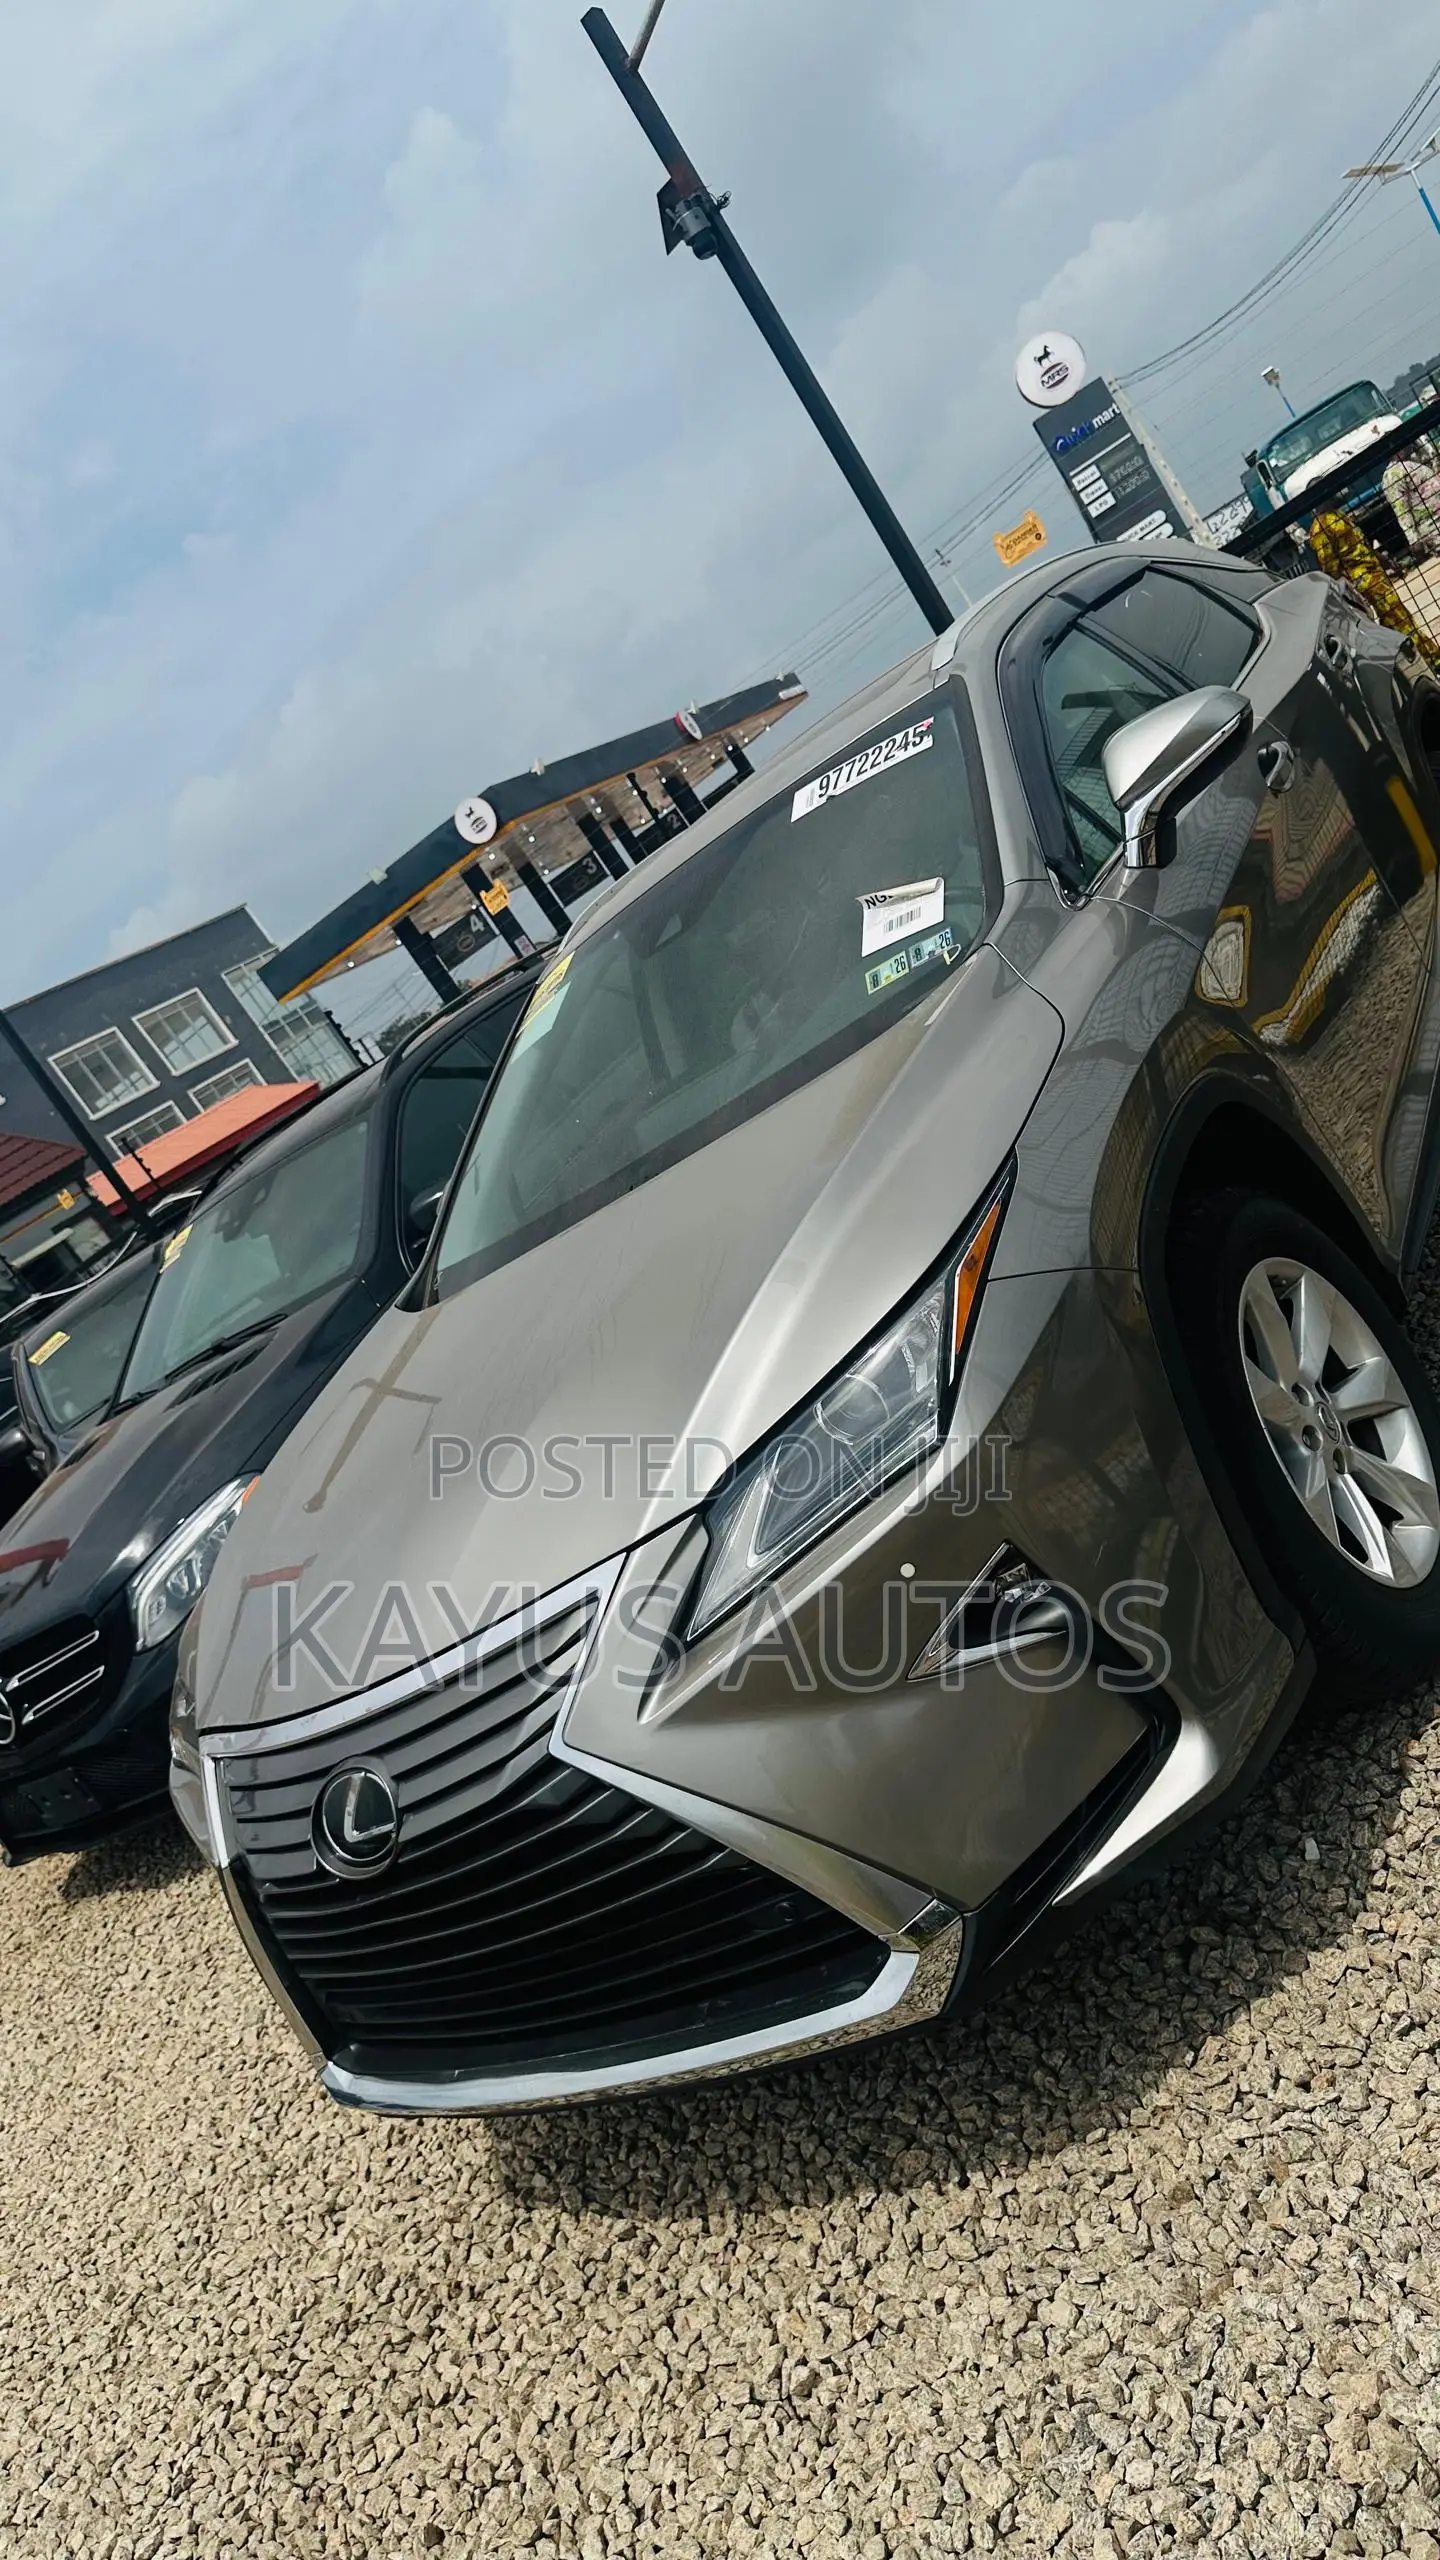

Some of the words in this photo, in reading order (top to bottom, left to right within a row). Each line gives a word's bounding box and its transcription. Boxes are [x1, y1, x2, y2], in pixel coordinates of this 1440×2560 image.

[1041, 363, 1069, 388] MRS
[1092, 402, 1120, 430] mart
[818, 723, 926, 799] 97722245
[667, 813, 682, 830] 2
[582, 857, 598, 874] 3
[864, 894, 894, 910] NG
[470, 914, 485, 933] 4
[938, 931, 952, 950] 26
[894, 955, 907, 974] 26
